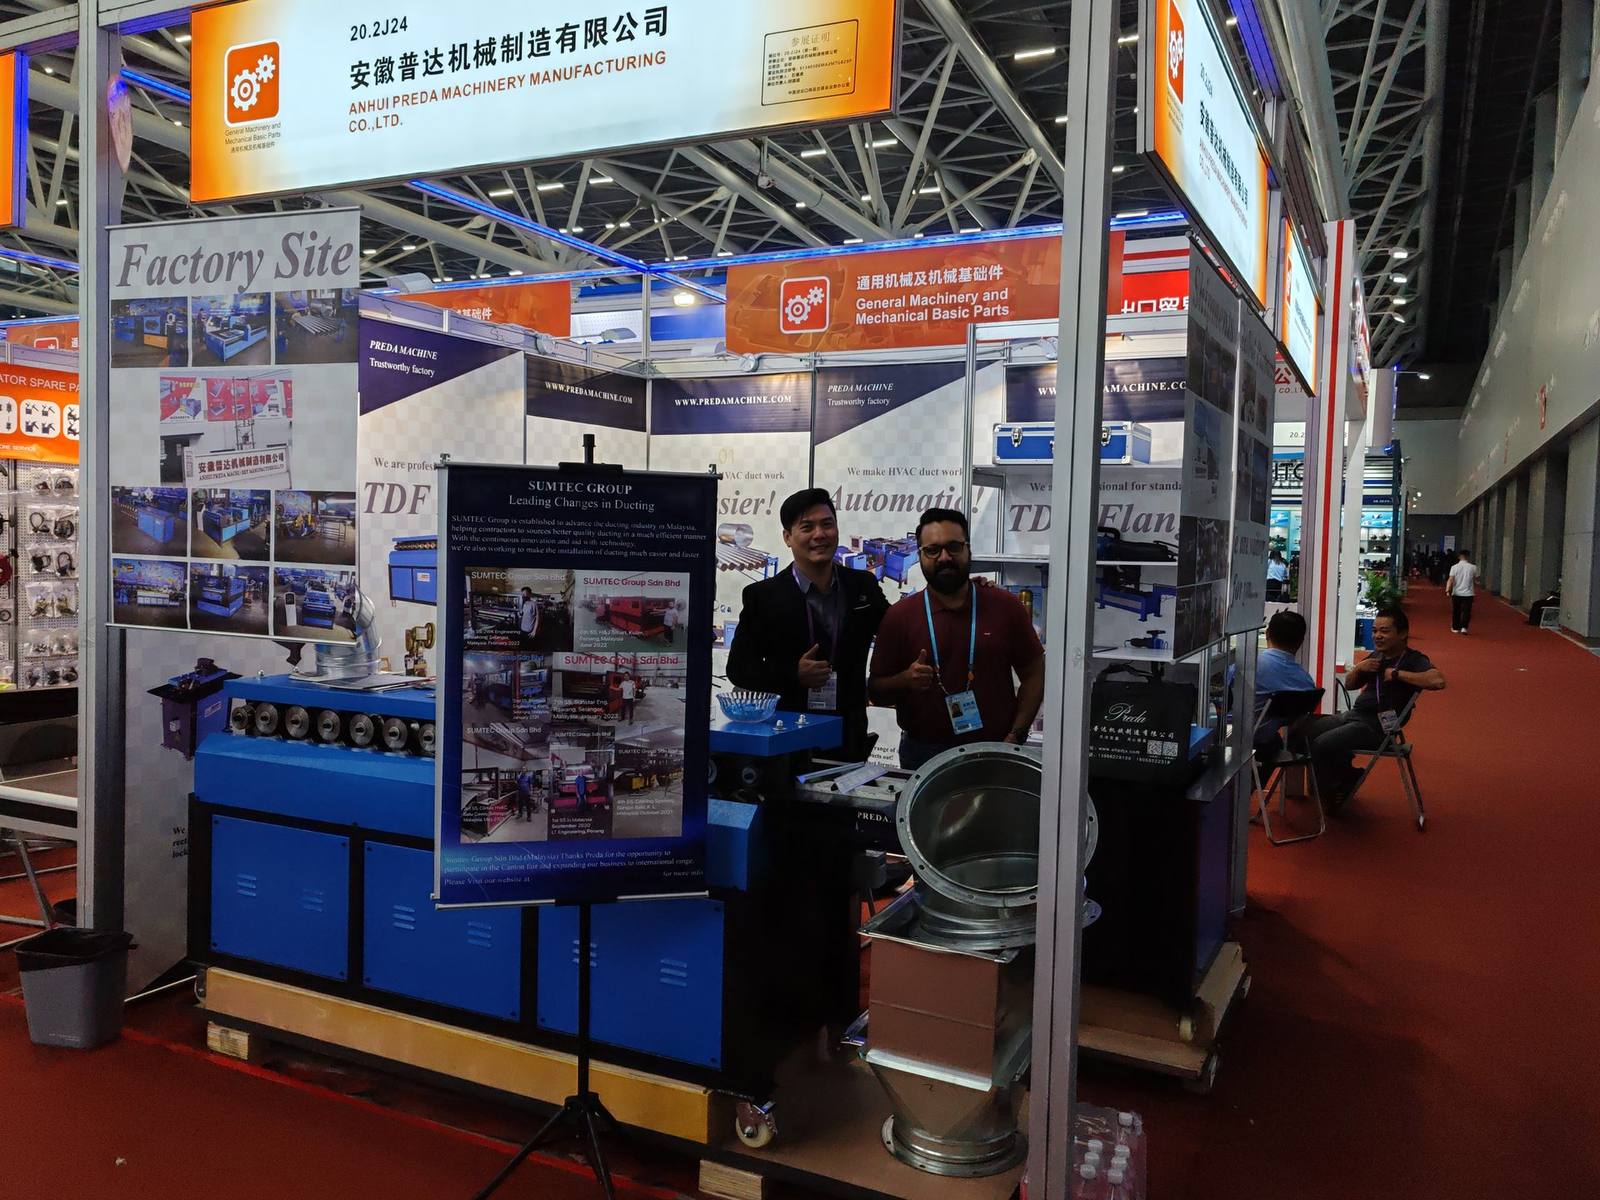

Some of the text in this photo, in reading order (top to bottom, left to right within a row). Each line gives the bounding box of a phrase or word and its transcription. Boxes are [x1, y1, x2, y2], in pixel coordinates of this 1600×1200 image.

[350, 16, 408, 41] 20.2J24
[350, 6, 667, 90] 安徽普达机械制造有限公司
[349, 50, 667, 115] ANHUI PREDA MACHINERY MANUFACTURING
[349, 113, 403, 132] CO.,LTD.
[115, 230, 354, 294] Factory Site
[856, 264, 1004, 291] 通用机械及机械基础件
[855, 287, 1009, 310] General Machinery and
[855, 303, 1010, 325] Mechanical Basic Parts
[369, 340, 438, 360] PREDA MACHINE
[369, 357, 435, 378] Trustworthy factory
[29, 377, 66, 392] SPARE
[827, 382, 894, 393] PREDA MACHINE
[544, 381, 633, 404] WWW.PREDAMACHINE.COM
[674, 395, 792, 406] WWW.PREDAMACHINE.COM
[827, 396, 891, 407] Trustworthy factory
[374, 457, 389, 468] We
[391, 461, 406, 469] are
[744, 471, 762, 480] duct
[764, 471, 785, 480] work
[847, 467, 861, 476] We
[863, 467, 886, 476] make
[888, 467, 917, 476] HVAC
[919, 467, 939, 476] duct
[527, 480, 633, 495] SUMTEC GROUP
[1030, 482, 1046, 491] We
[1131, 481, 1147, 491] for
[363, 482, 432, 515] TDF
[508, 494, 656, 513] Leading Changes in Ducting
[451, 514, 487, 523] SUMTEC
[487, 515, 510, 525] Group
[518, 517, 555, 526] established
[1097, 503, 1180, 536] Flan
[451, 525, 477, 534] helping
[572, 529, 595, 538] quality
[597, 530, 622, 540] ducting
[655, 532, 683, 540] efficient
[451, 544, 471, 552] we're
[488, 545, 516, 554] working
[526, 546, 545, 554] make
[603, 549, 629, 558] ducting
[471, 571, 507, 580] SUMTEC
[583, 577, 620, 585] SUMTEC
[621, 578, 646, 587] Group
[647, 579, 663, 587] Sdn
[564, 655, 608, 665] SUMTEC
[640, 656, 658, 665] Sdn
[659, 655, 679, 664] Bhd
